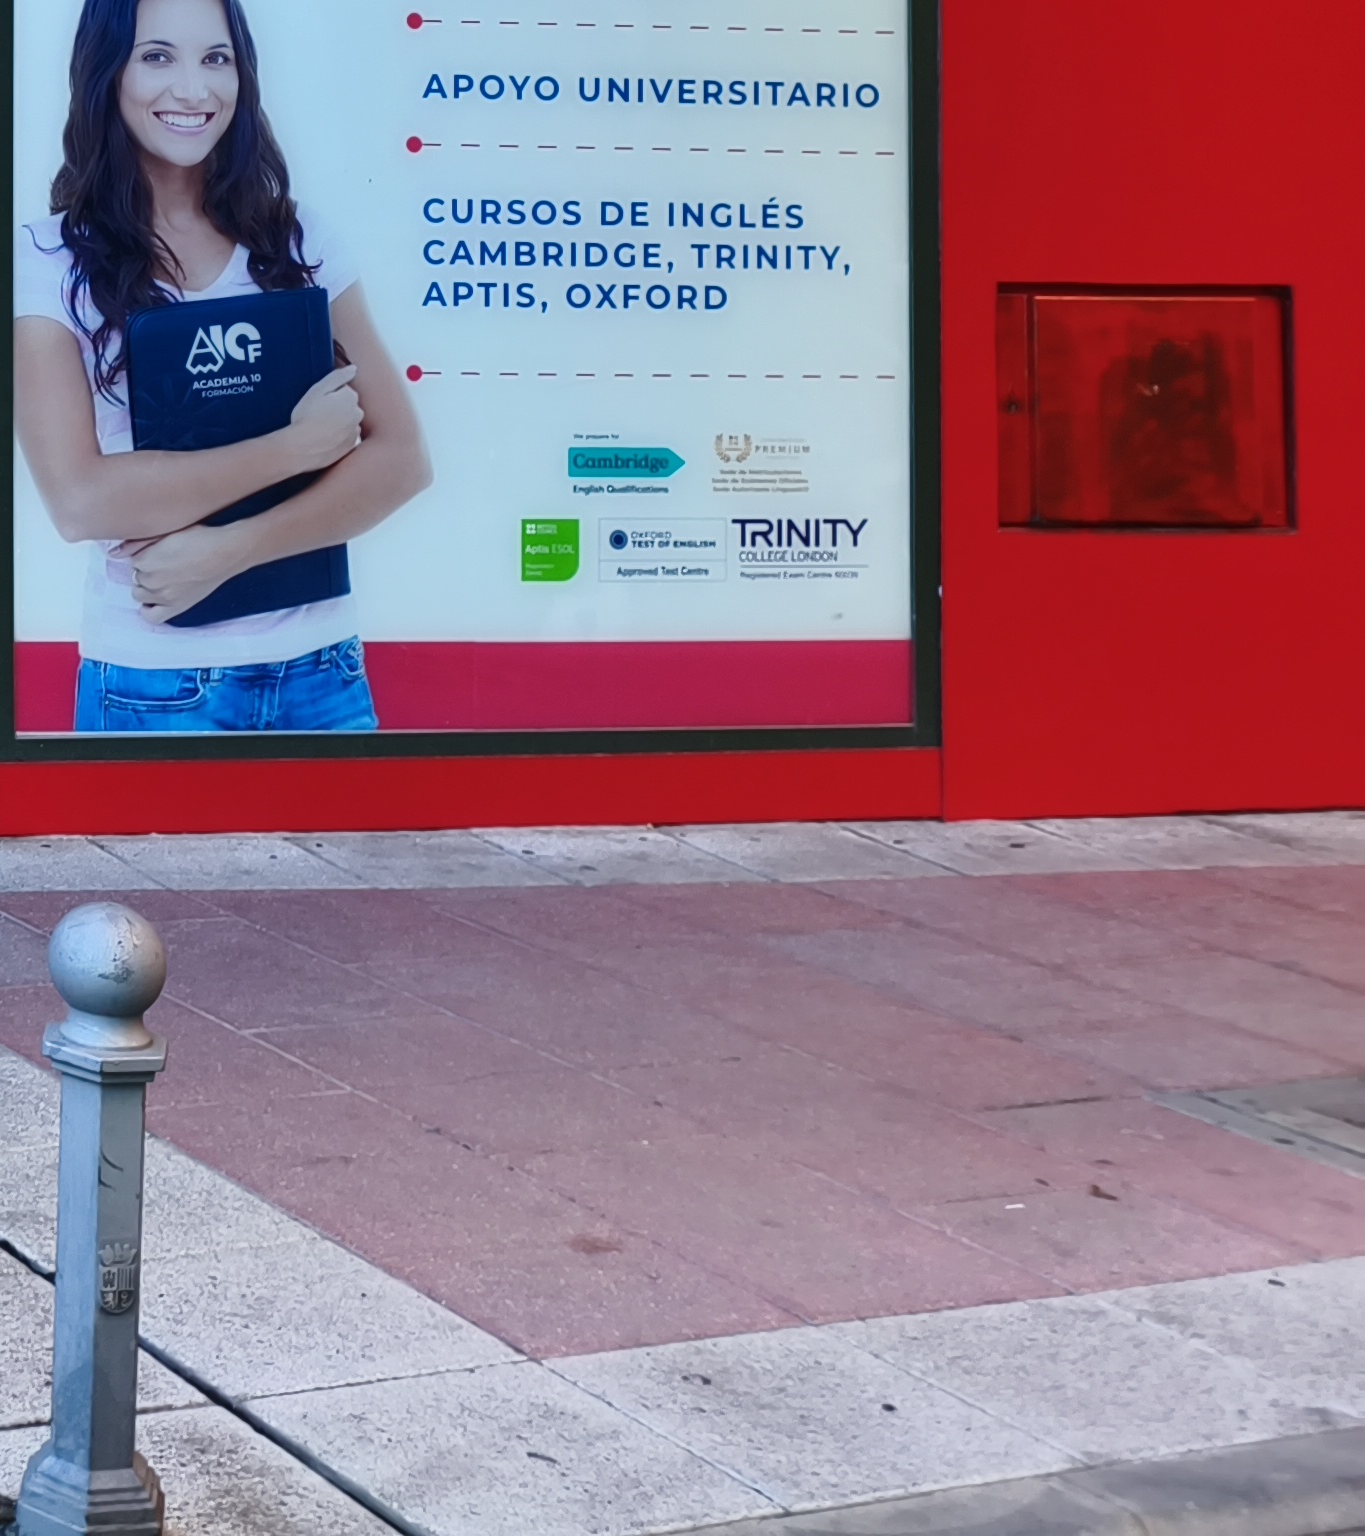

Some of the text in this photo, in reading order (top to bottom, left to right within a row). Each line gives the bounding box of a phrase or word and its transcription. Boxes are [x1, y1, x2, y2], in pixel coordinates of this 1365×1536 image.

[423, 73, 880, 108] APOYO UNIVERSITARIO
[423, 197, 804, 229] CURSOS DE INGLÉS
[423, 240, 851, 275] CAMBRIDGE, TRINITY,
[422, 282, 728, 313] APTIS, OXFORD
[193, 373, 261, 390] ACADEMIA 10
[202, 384, 254, 398] FORMACIÓN
[573, 453, 669, 473] Cambridge
[631, 531, 672, 539] OXFORD
[731, 519, 868, 547] TRINITY
[739, 550, 838, 562] COLLEGE LONDON
